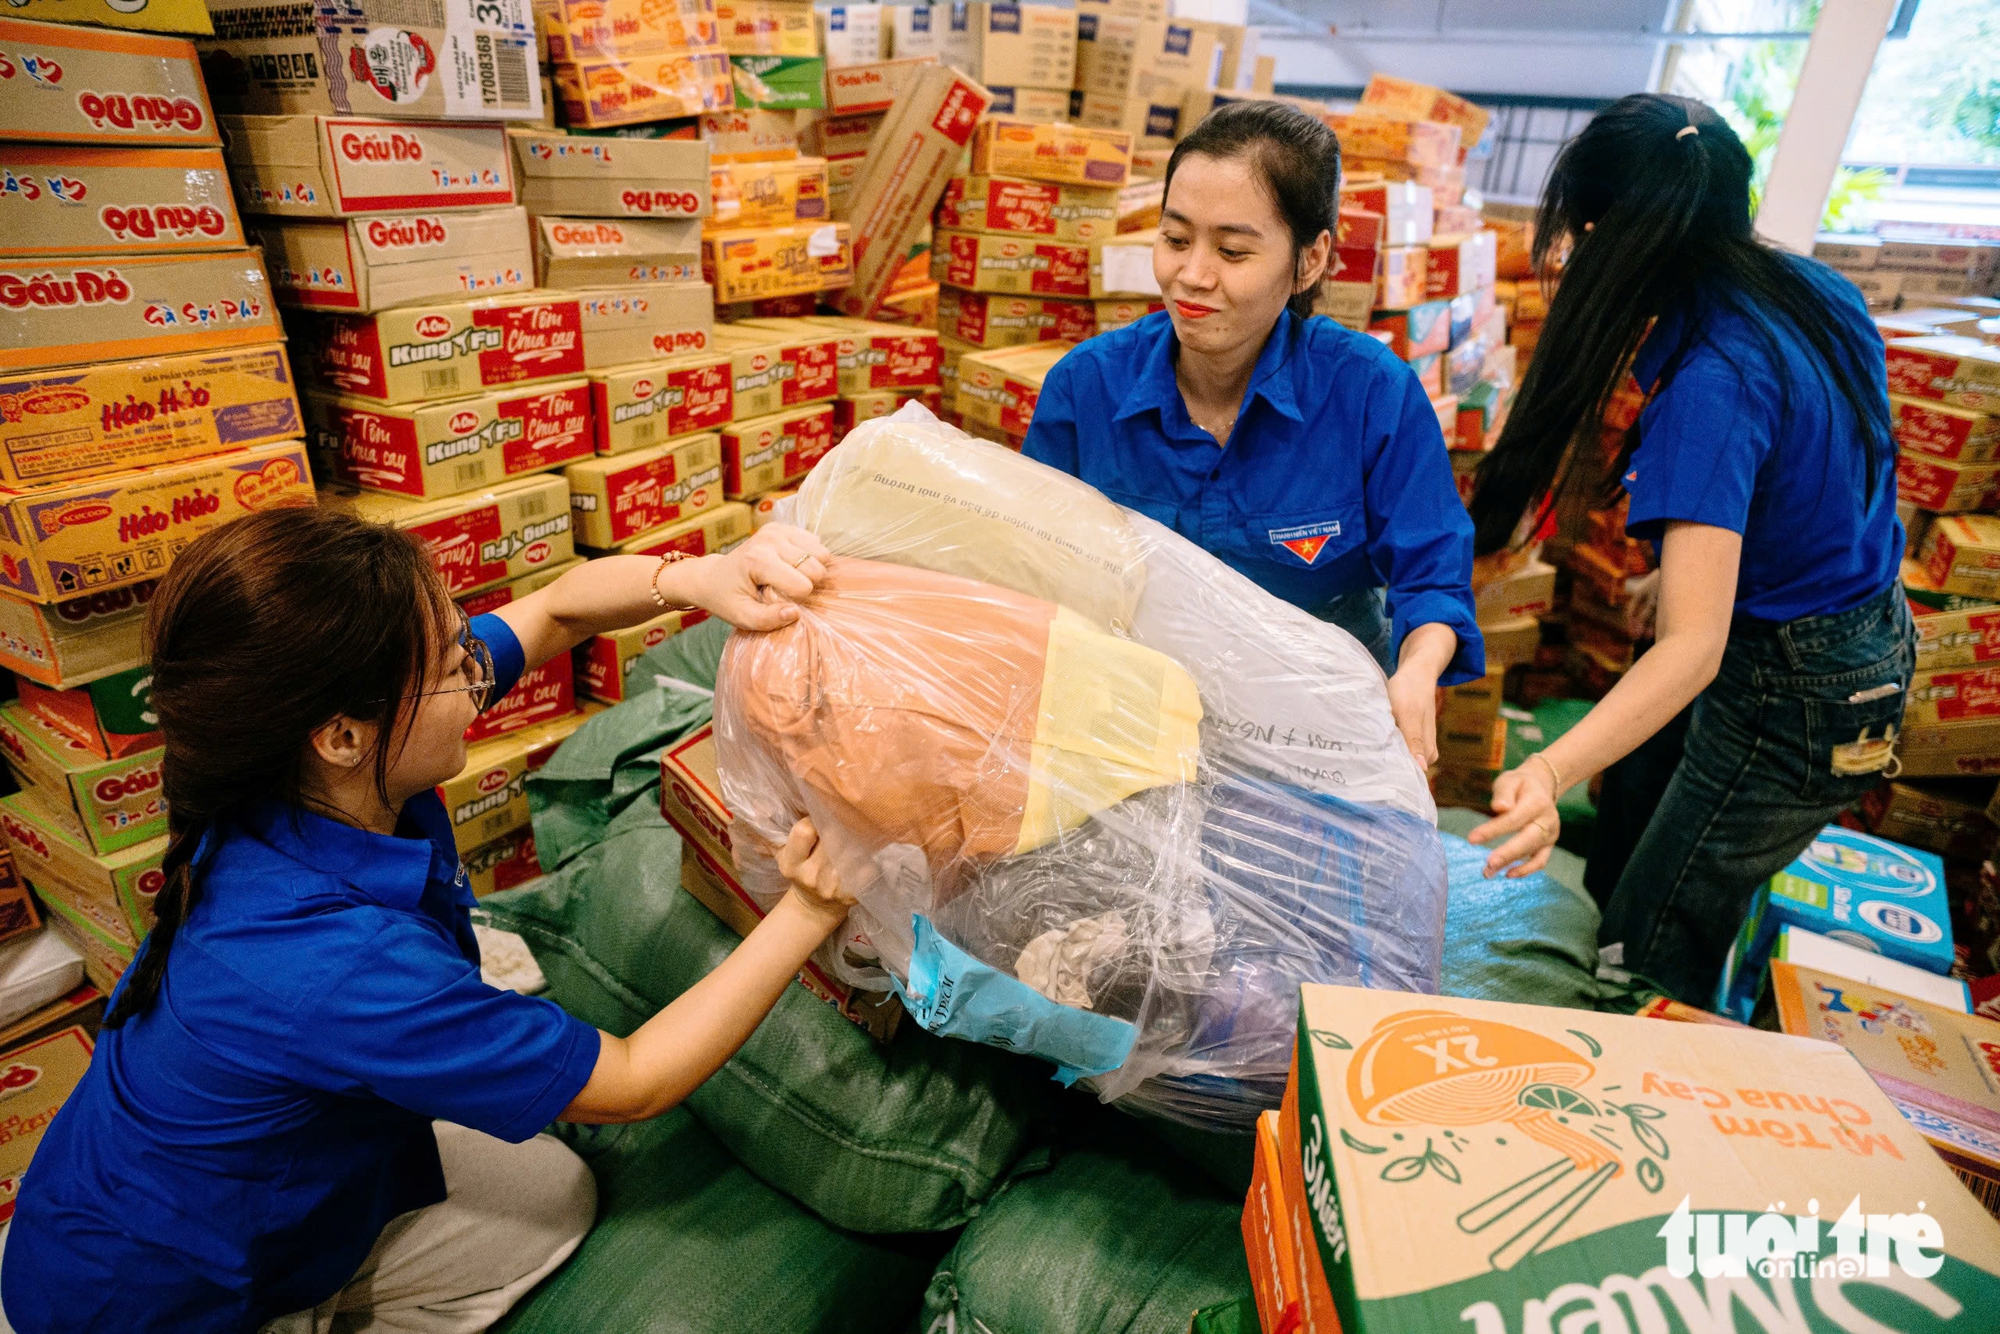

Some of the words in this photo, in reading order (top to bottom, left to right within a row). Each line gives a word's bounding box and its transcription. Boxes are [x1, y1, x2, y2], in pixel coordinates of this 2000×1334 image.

[390, 337, 453, 367] Kung
[470, 330, 499, 348] Fu
[427, 436, 480, 465] Kung
[496, 420, 521, 439] Fu
[523, 515, 569, 542] Kung
[482, 542, 508, 561] Fu
[455, 788, 509, 826] Kung
[1413, 1034, 1499, 1075] 2X
[1640, 1072, 1731, 1109] Cay
[1734, 1085, 1872, 1126] Chua
[1711, 1114, 1828, 1153] Tôm
